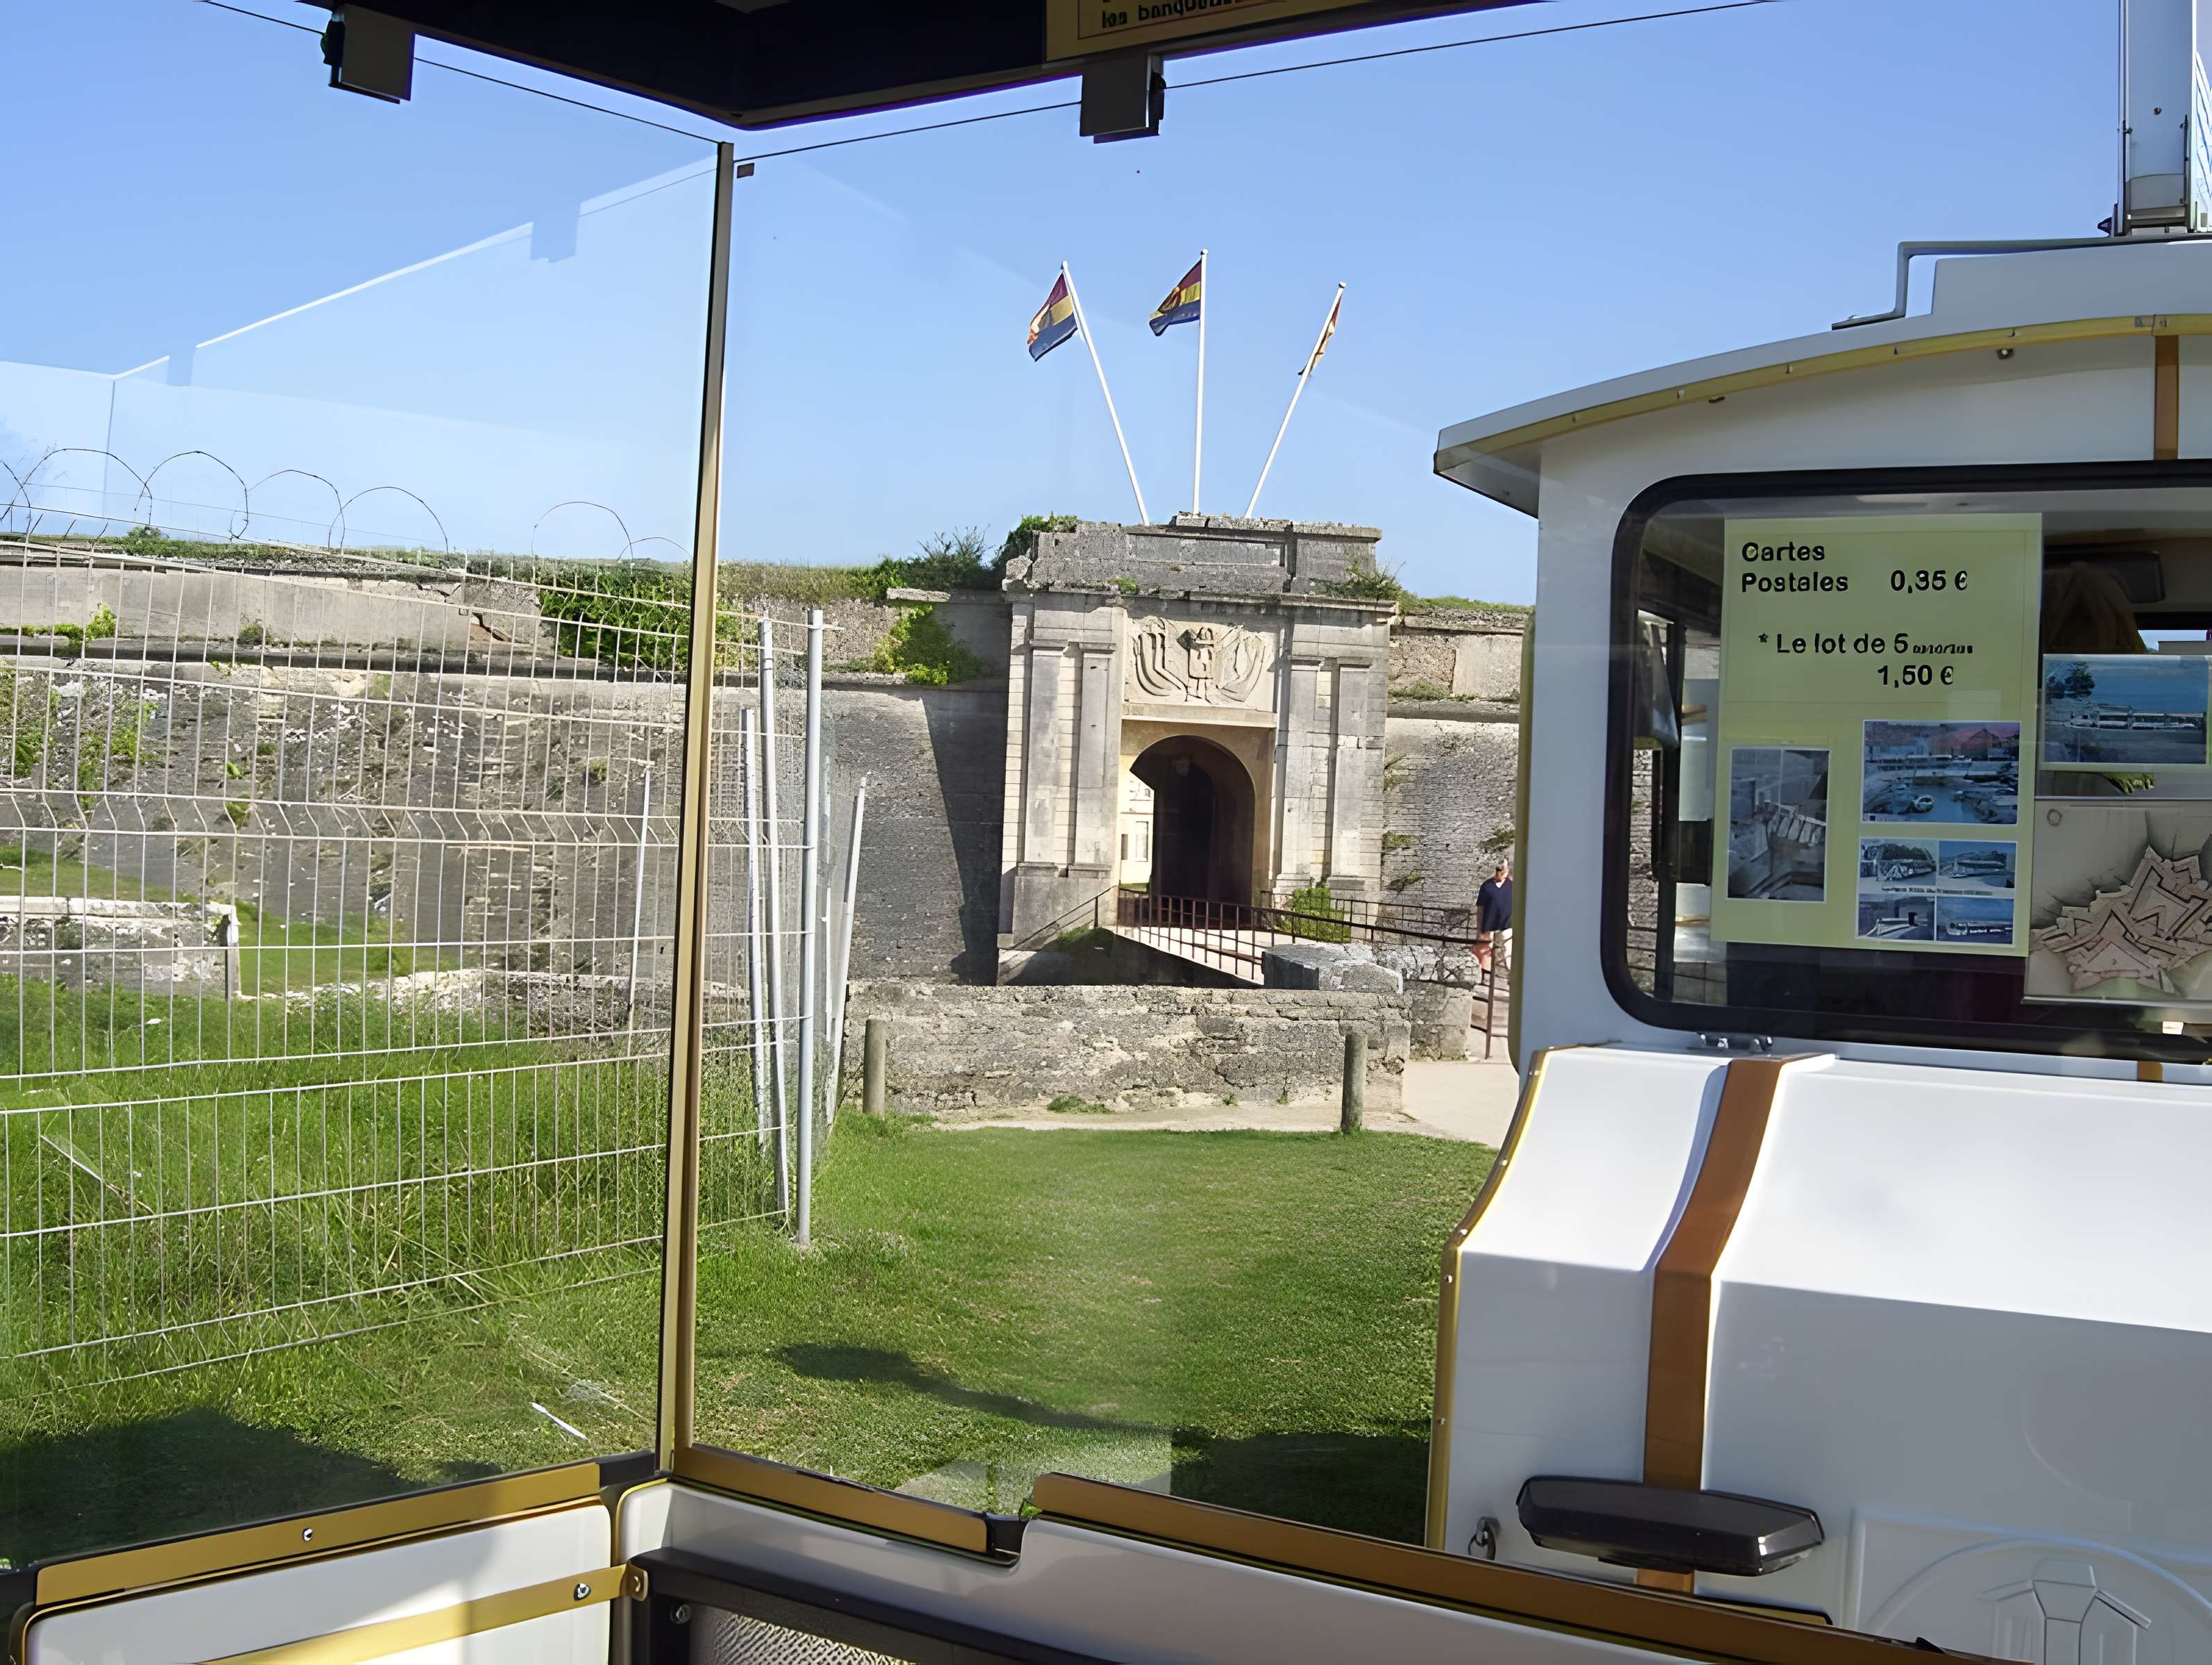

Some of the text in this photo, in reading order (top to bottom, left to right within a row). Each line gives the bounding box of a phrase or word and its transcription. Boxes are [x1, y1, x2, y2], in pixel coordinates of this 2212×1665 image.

[1742, 542, 1826, 562] Cartes
[1742, 570, 1968, 594] Postales 0,35 €
[1776, 633, 1807, 654] Le
[1814, 633, 1846, 654] lot
[1853, 633, 1885, 654] de
[1894, 633, 1909, 654] 5
[1877, 665, 1955, 688] 1,50 €
